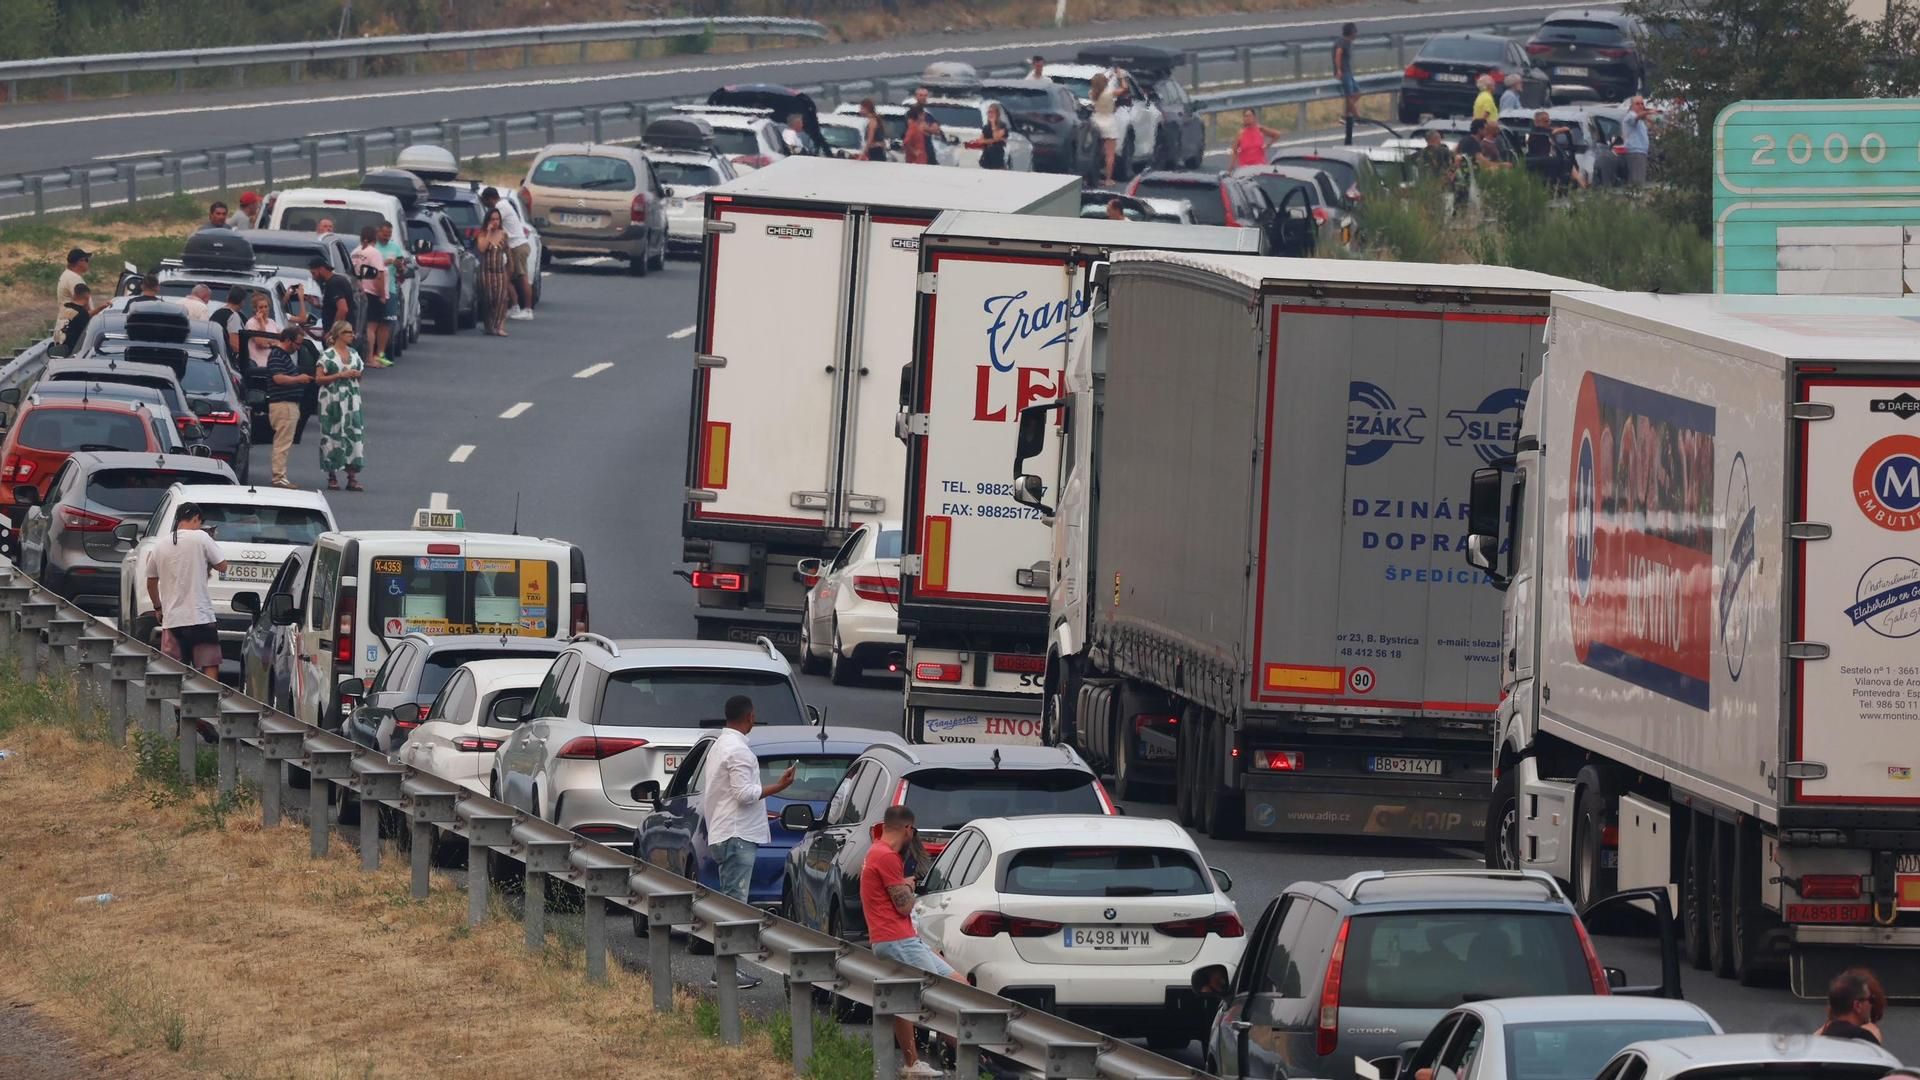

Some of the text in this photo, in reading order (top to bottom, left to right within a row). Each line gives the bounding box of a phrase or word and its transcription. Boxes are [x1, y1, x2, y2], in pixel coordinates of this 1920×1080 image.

[1752, 133, 1886, 164] 2000
[767, 226, 812, 237] CHEREAU
[1882, 466, 1920, 498] M
[942, 481, 1048, 498] TEL. 988237
[943, 504, 1042, 520] FAX: 98825172
[1858, 489, 1920, 527] EMBUTI
[431, 514, 454, 526] TAXI
[1362, 531, 1512, 555] DOPRAA
[229, 566, 279, 579] 4666 MX
[1385, 565, 1494, 585] ŠPEDÍCIA
[1350, 633, 1364, 644] 23,
[1379, 635, 1419, 646] Bystrica
[1437, 638, 1470, 648] e-mail:
[1355, 649, 1372, 657] 412
[1840, 666, 1872, 675] Sestelo
[1354, 673, 1370, 687] 90
[1855, 677, 1891, 686] Vilanova
[1893, 678, 1904, 686] de
[1852, 689, 1900, 698] Pontevedra
[1876, 700, 1893, 709] 986
[1895, 700, 1905, 709] 50
[939, 736, 976, 744] VOLVO
[1075, 930, 1150, 945] 6498 MYM
